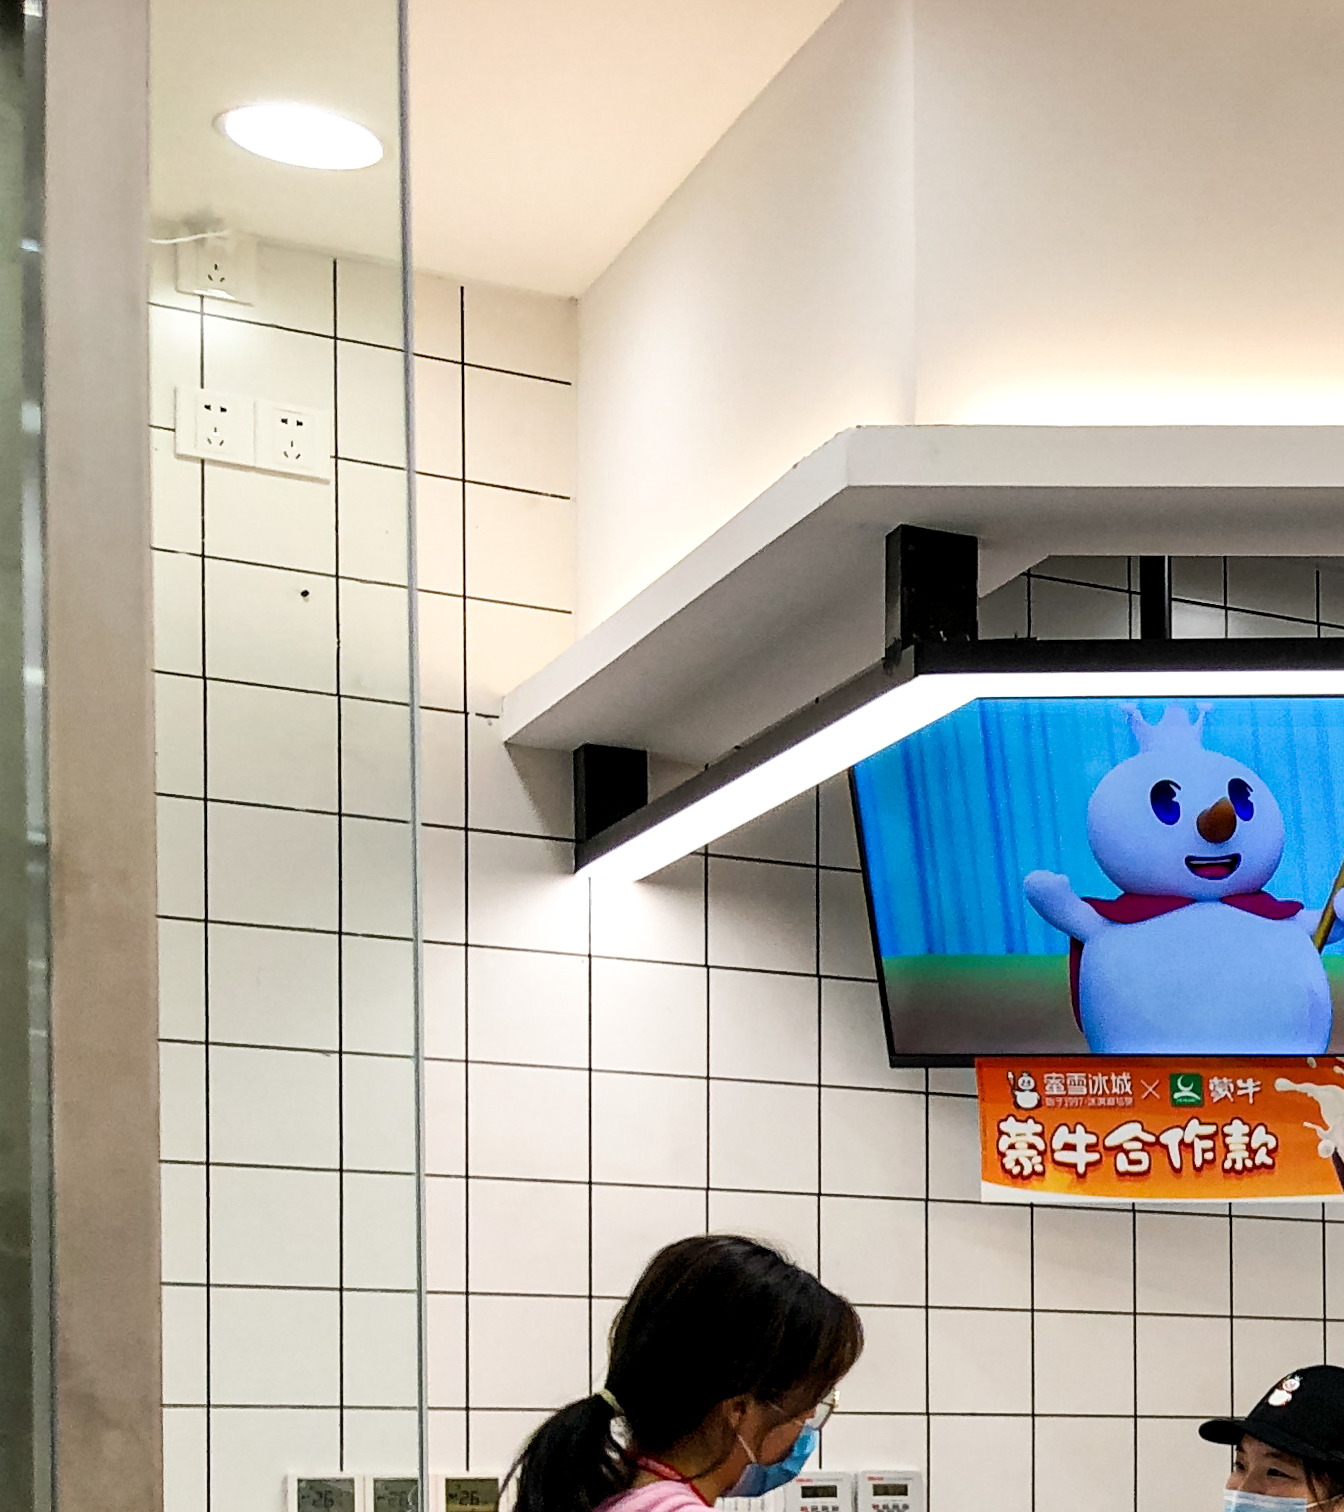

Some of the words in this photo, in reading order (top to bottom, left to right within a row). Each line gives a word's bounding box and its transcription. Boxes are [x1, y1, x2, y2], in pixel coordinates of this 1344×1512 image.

[1043, 1072, 1133, 1096] 蜜雪冰城
[1208, 1075, 1262, 1105] 蒙牛
[997, 1116, 1279, 1179] 蒙牛合作款
